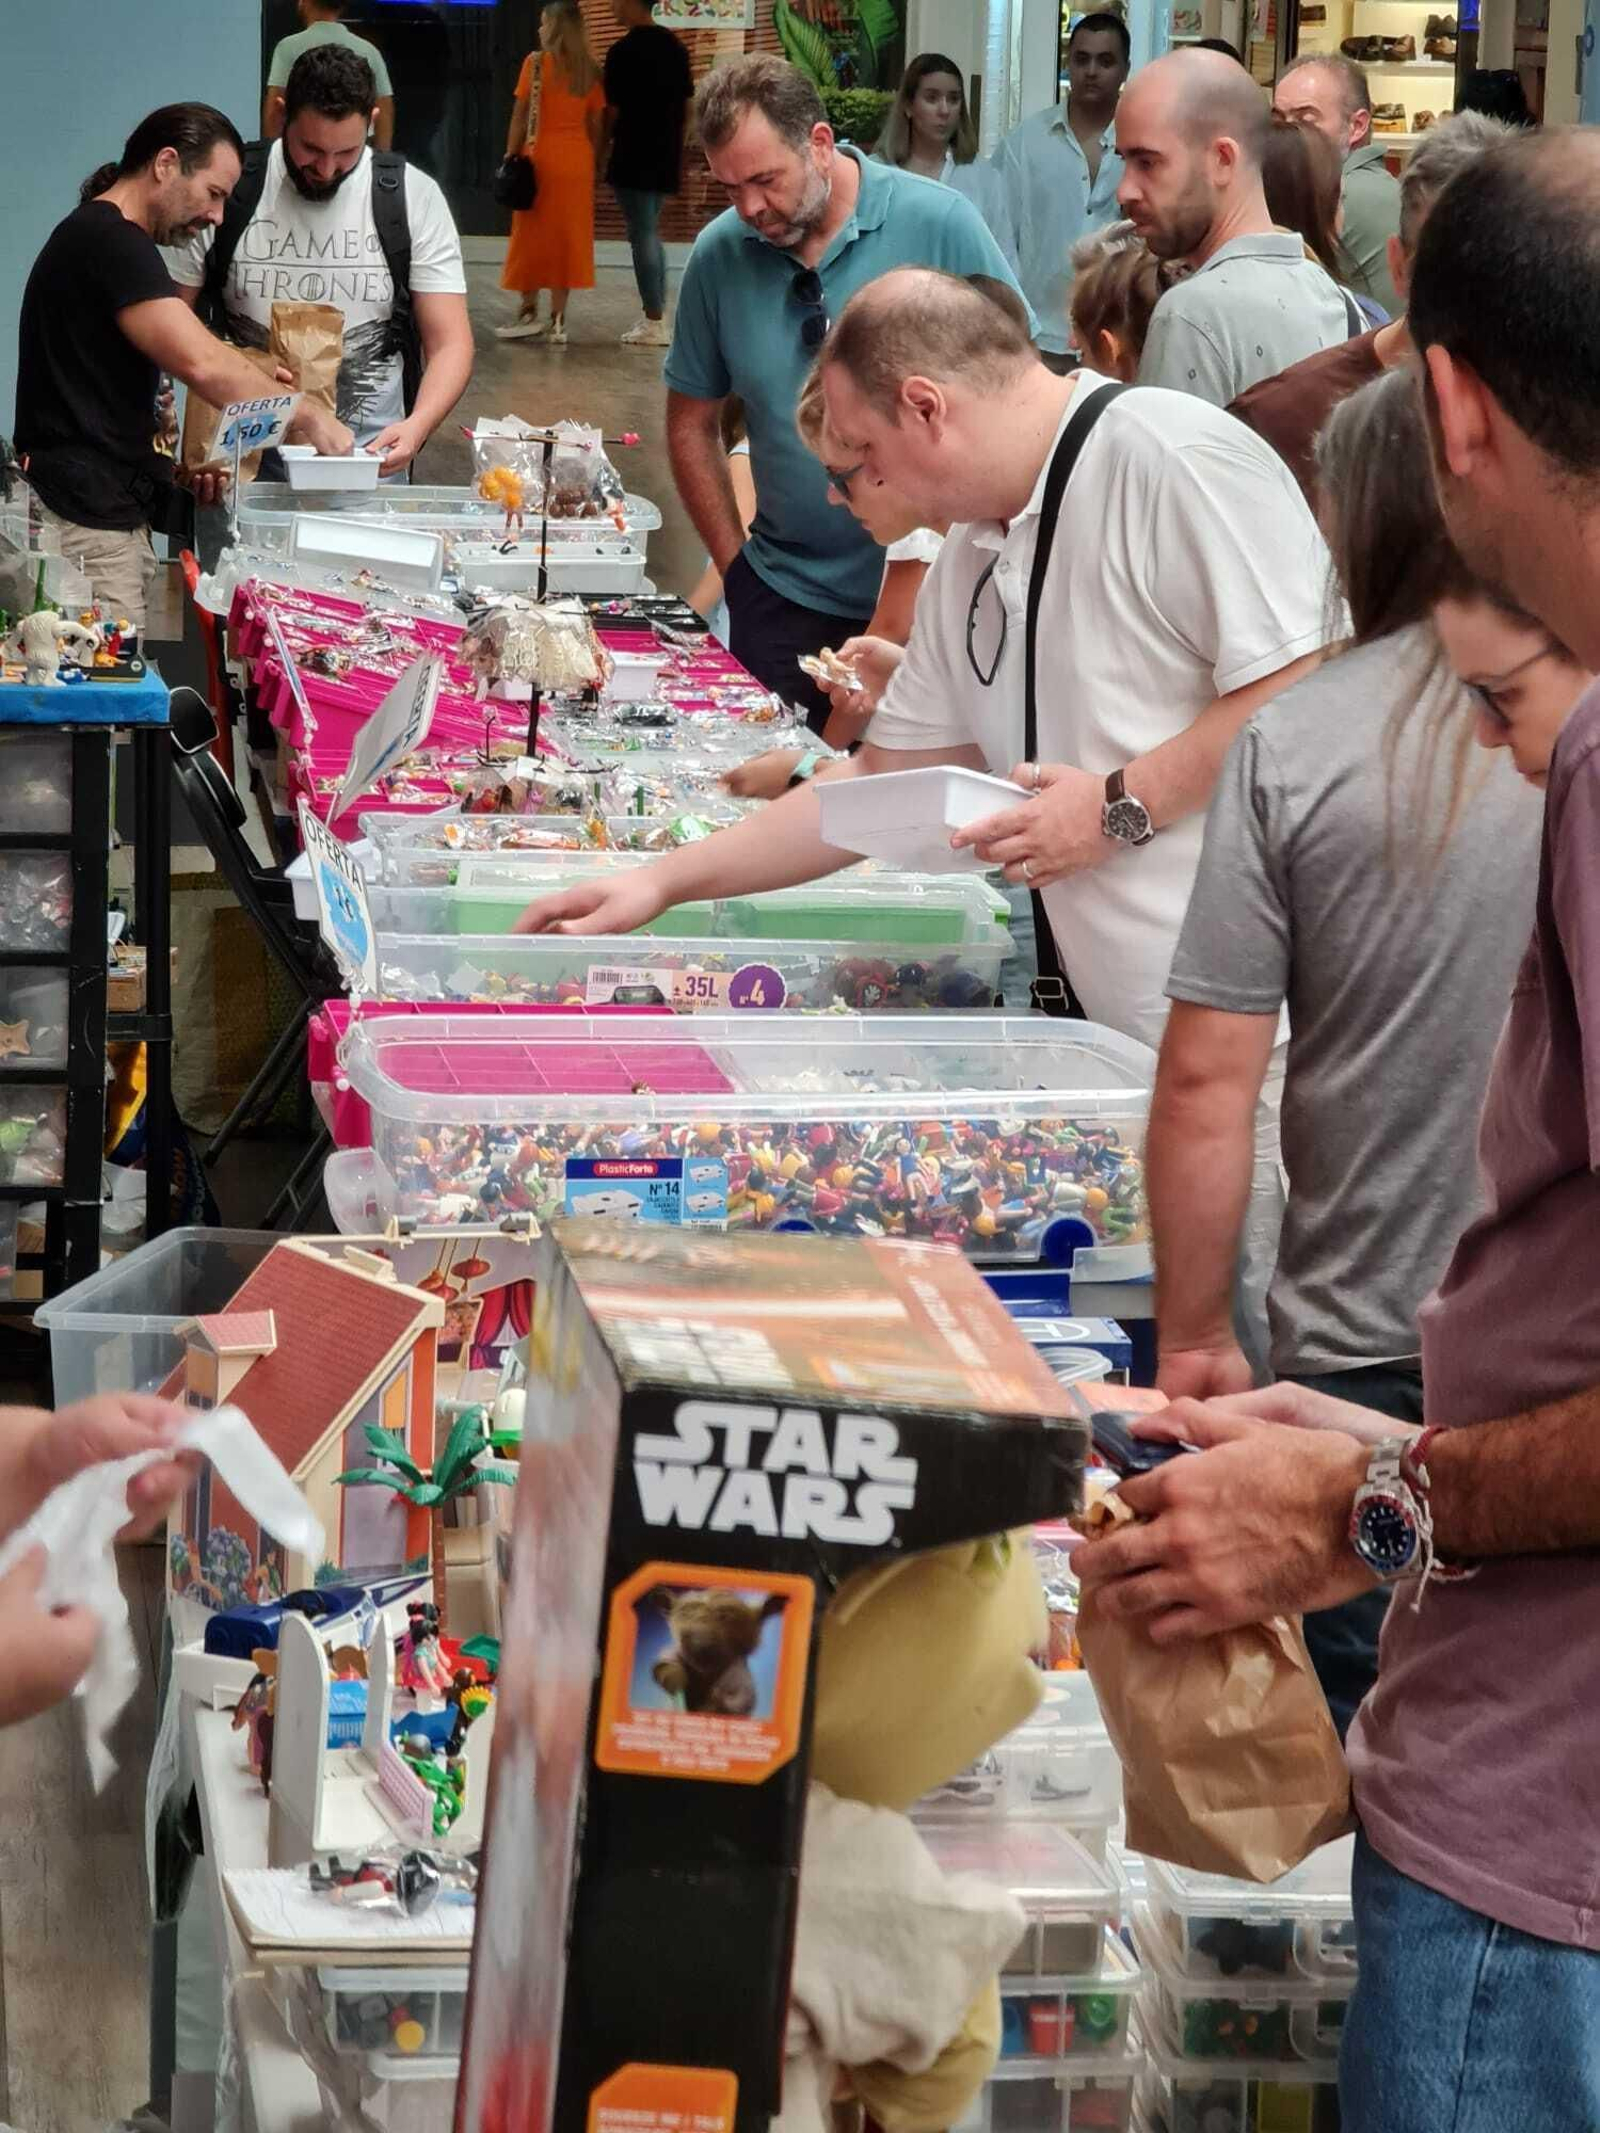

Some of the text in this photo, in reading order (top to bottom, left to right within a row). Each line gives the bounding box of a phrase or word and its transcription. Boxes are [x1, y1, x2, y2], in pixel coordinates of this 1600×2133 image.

[242, 219, 359, 261] GAME
[227, 396, 291, 416] OFERTA
[219, 423, 262, 447] 1,50
[304, 814, 363, 893] OFERTA
[685, 976, 719, 998] 35L
[750, 979, 766, 1006] 4
[665, 1181, 680, 1195] 14
[634, 1400, 919, 1484] STAR
[633, 1461, 916, 1546] WARS
